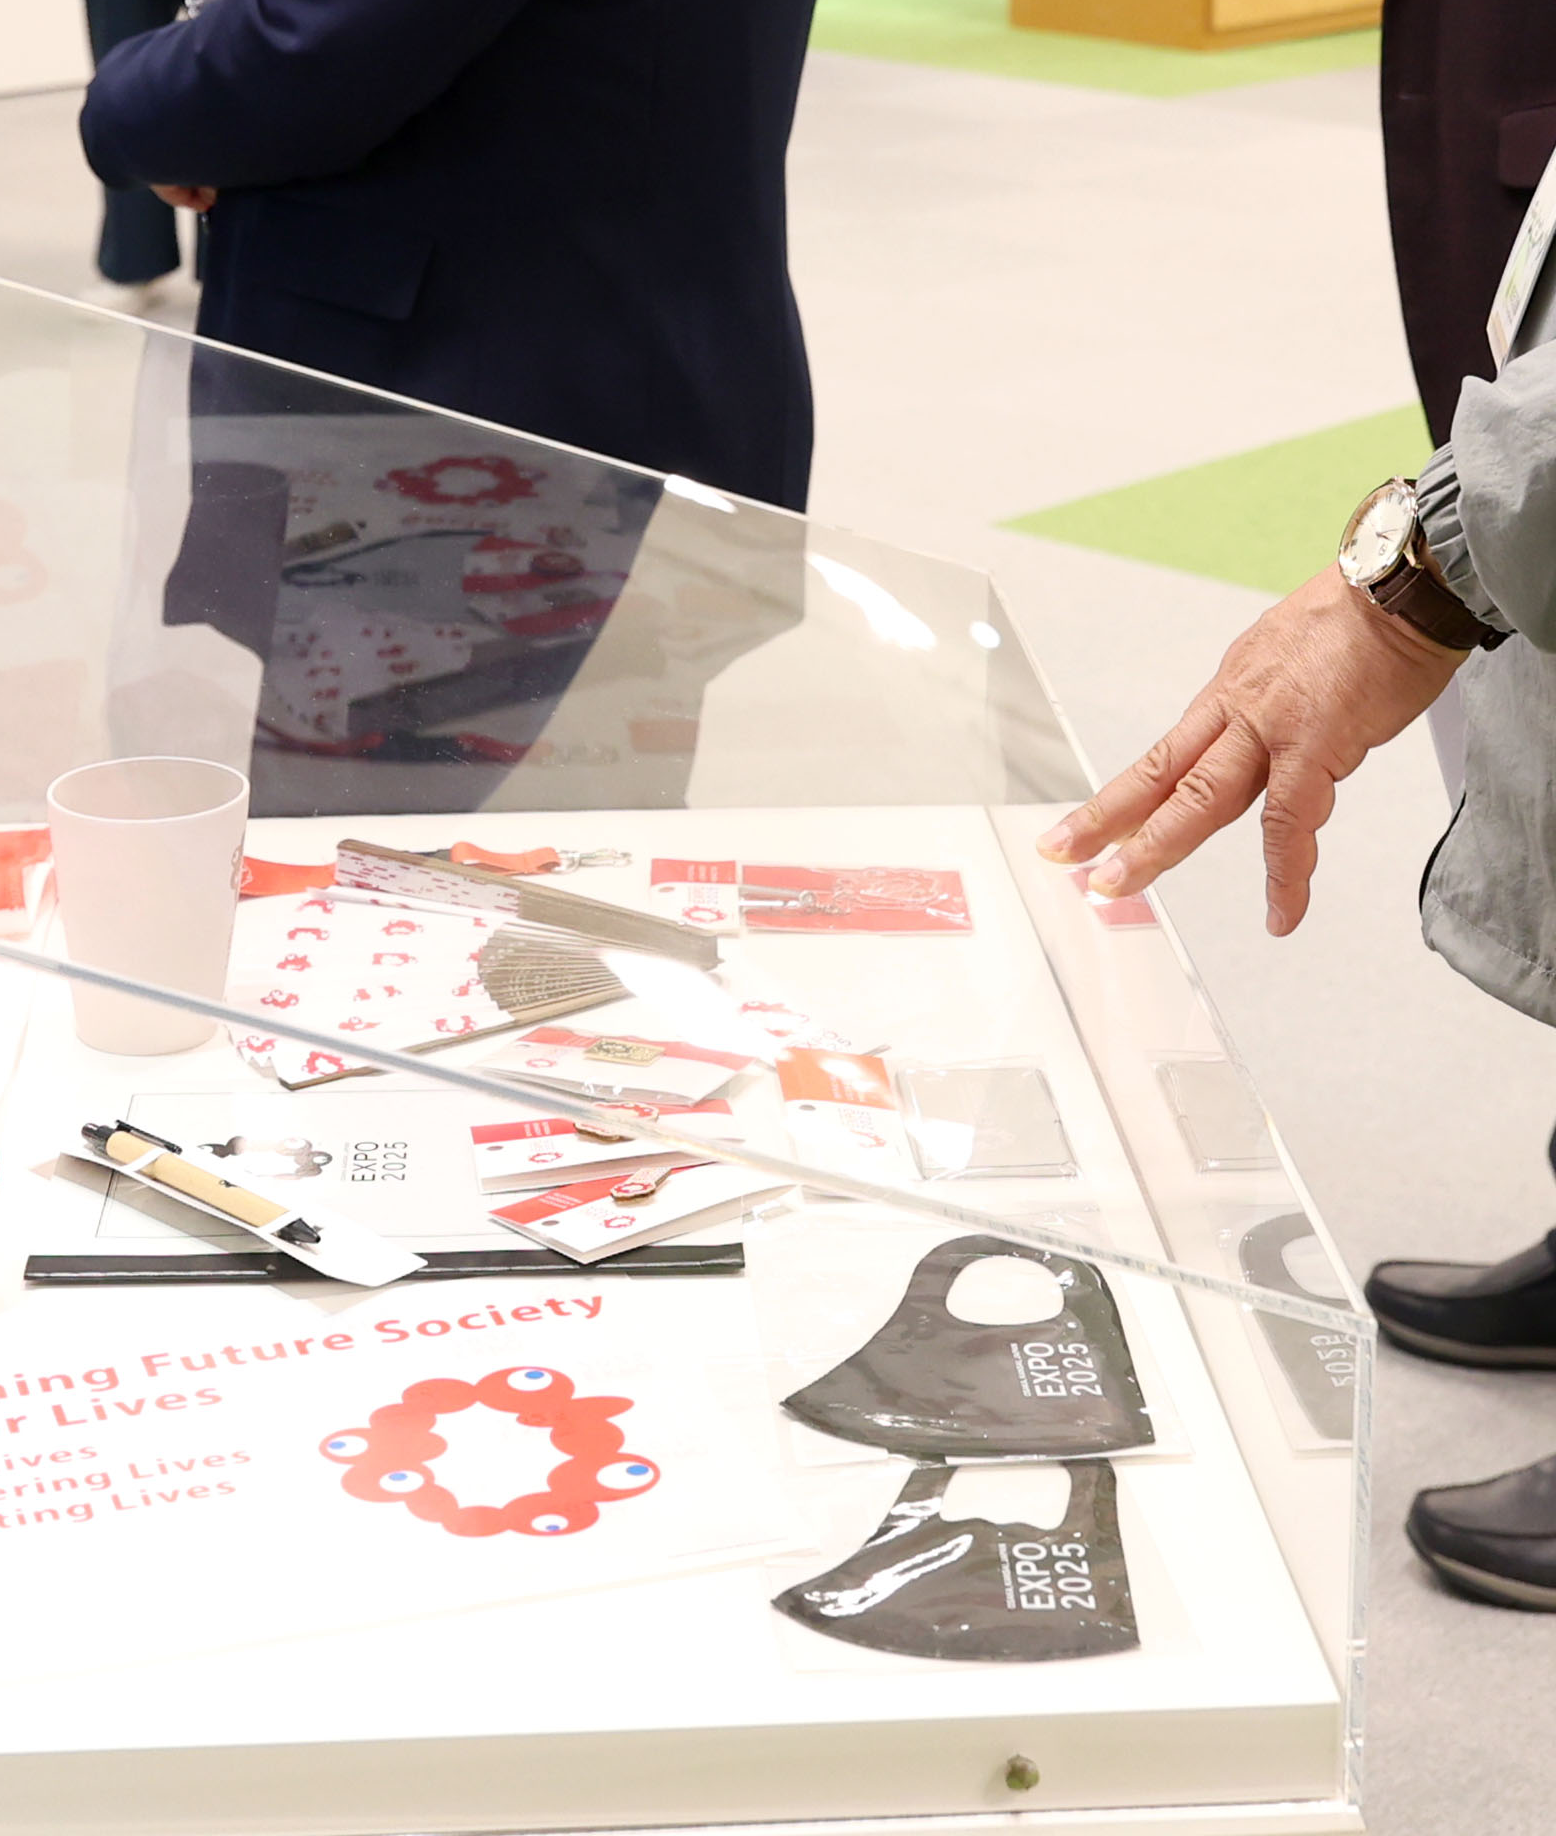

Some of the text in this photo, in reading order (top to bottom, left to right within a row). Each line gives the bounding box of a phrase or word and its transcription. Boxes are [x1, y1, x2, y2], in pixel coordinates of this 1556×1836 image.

[351, 1141, 379, 1182] EXPO
[381, 1141, 408, 1181] 2025
[140, 1332, 355, 1378] Future
[373, 1294, 604, 1344] Society
[1023, 1341, 1067, 1397] EXPO
[1057, 1342, 1103, 1397] 2025
[51, 1385, 223, 1428] Lives
[128, 1449, 253, 1480] Lives
[111, 1478, 237, 1511] Lives
[1011, 1542, 1056, 1610] EXPO
[1051, 1543, 1096, 1610] 2025
